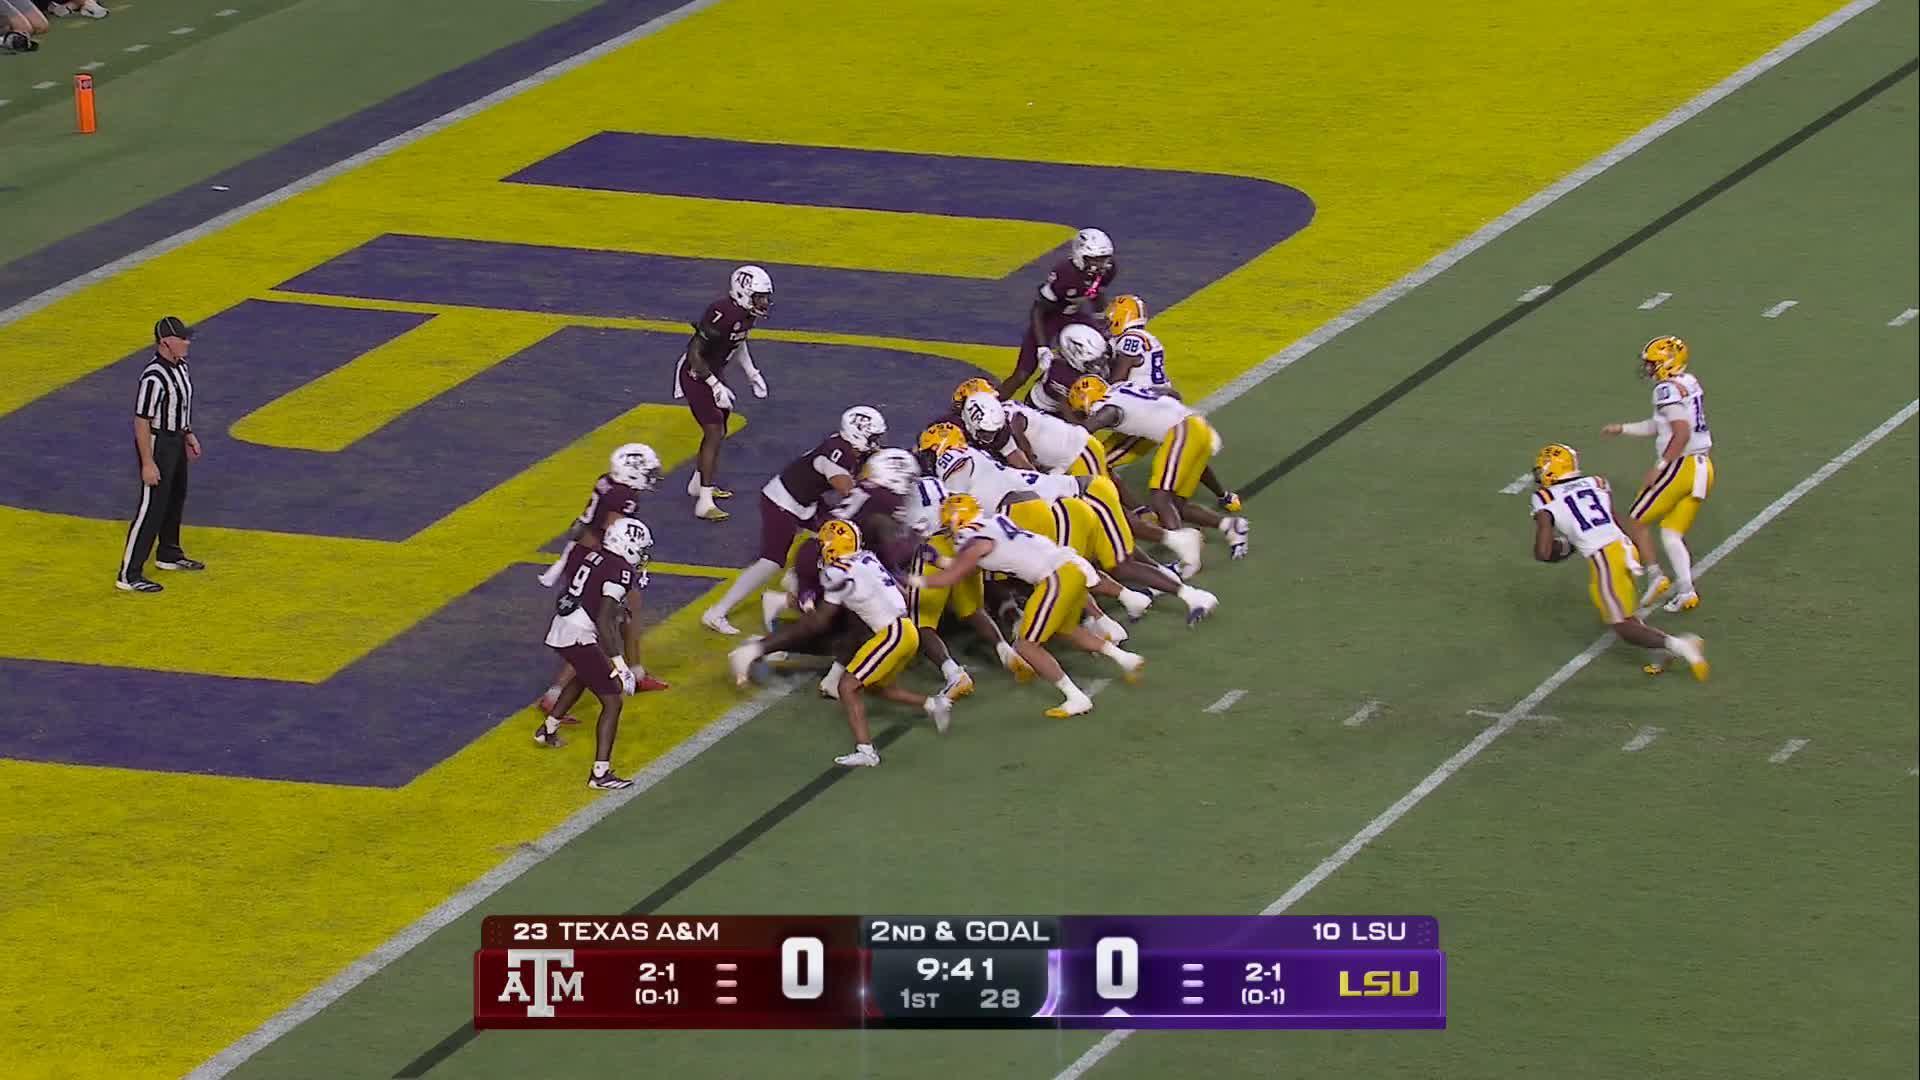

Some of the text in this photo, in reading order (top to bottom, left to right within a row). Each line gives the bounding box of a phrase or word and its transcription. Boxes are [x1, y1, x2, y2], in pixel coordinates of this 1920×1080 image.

[711, 309, 723, 324] 7
[1122, 338, 1140, 353] 88
[937, 452, 954, 470] 50
[1563, 488, 1611, 532] 13
[568, 563, 592, 597] 9
[621, 569, 632, 584] 9
